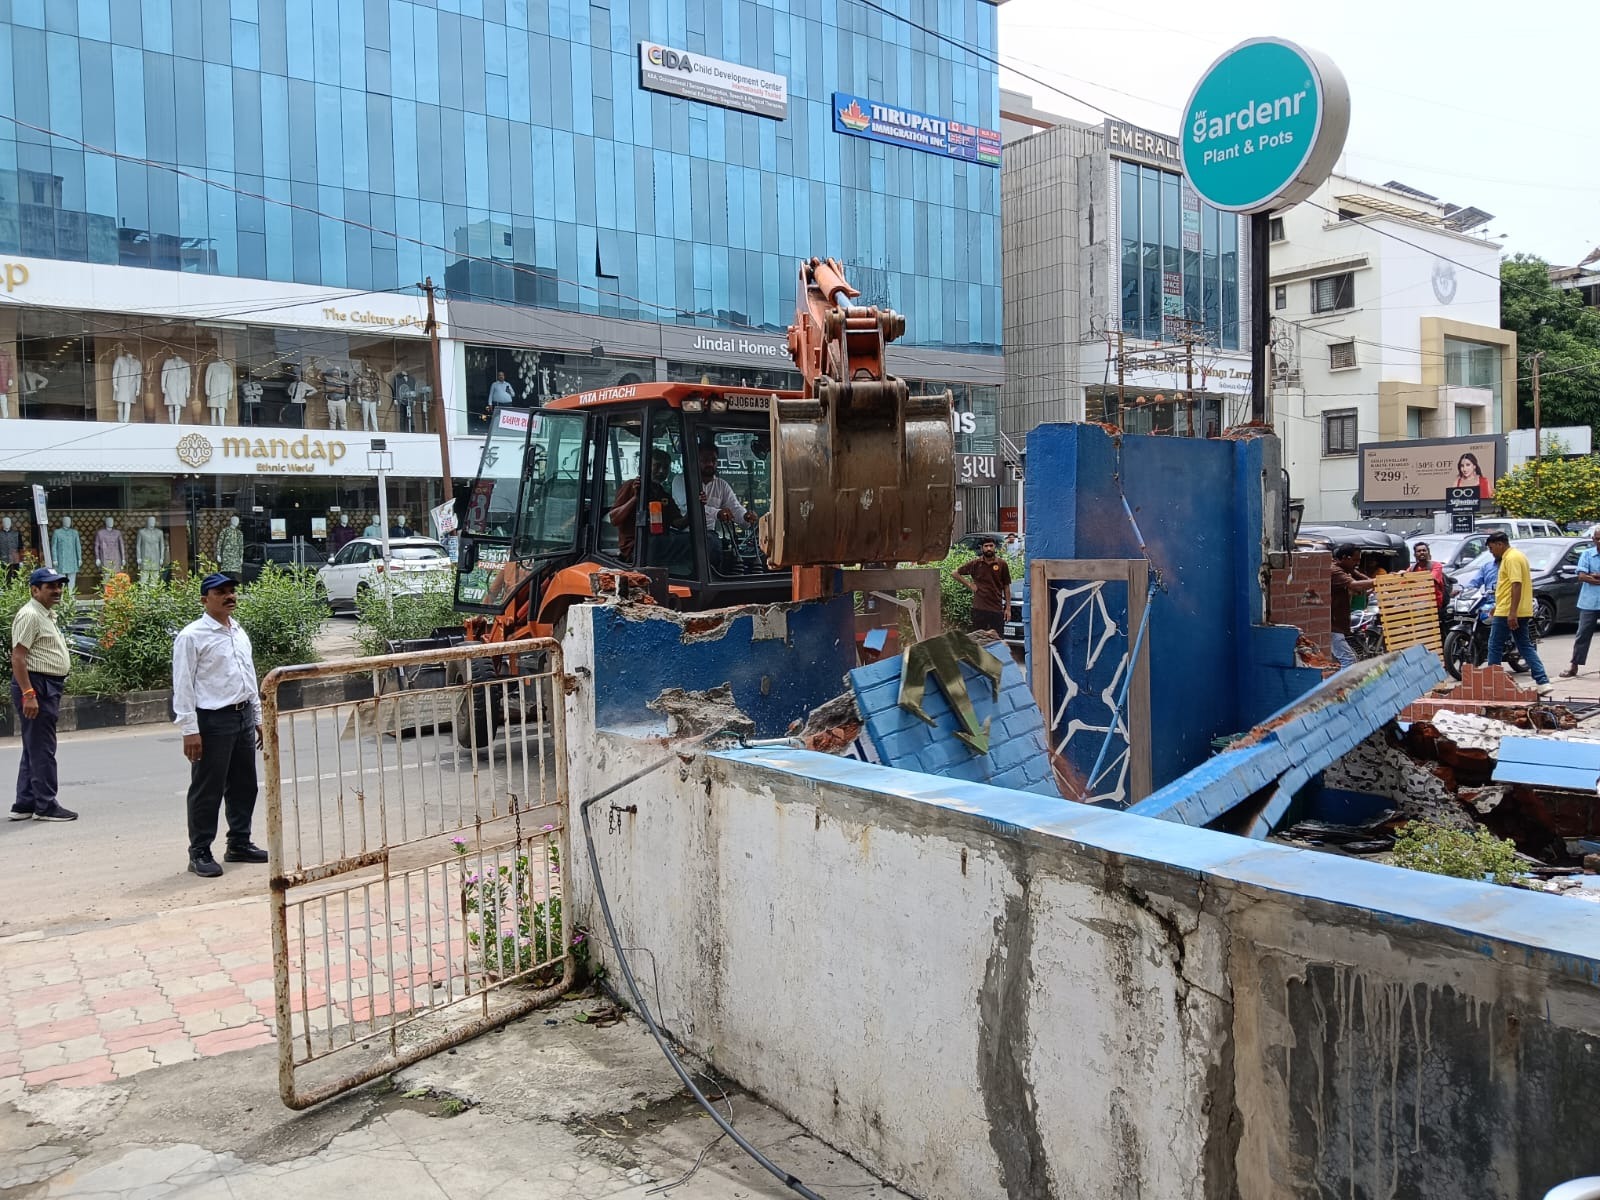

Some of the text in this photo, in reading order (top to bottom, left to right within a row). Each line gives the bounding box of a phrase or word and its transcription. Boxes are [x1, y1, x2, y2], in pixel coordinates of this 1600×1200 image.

[648, 46, 692, 73] CIDA
[693, 63, 783, 92] Child Development Center
[764, 90, 782, 100] Trusted
[870, 104, 947, 136] TIRUPATI
[1193, 91, 1306, 143] gardenr
[1195, 110, 1207, 120] Mr
[871, 122, 947, 148] IMMIGRATION INC.
[1110, 126, 1179, 160] EMERAL
[1203, 131, 1293, 165] Plant & Pots
[0, 264, 28, 292] p
[323, 308, 347, 321] The
[351, 311, 395, 326] Culture
[399, 314, 412, 327] of
[693, 335, 793, 361] Jindal Home S
[579, 387, 636, 404] TATA HITACHI
[222, 434, 347, 466] mandap
[256, 463, 314, 472] Ethnic World
[961, 455, 996, 478] કાયા
[1436, 460, 1453, 468] OFF
[478, 560, 506, 570] PRIME
